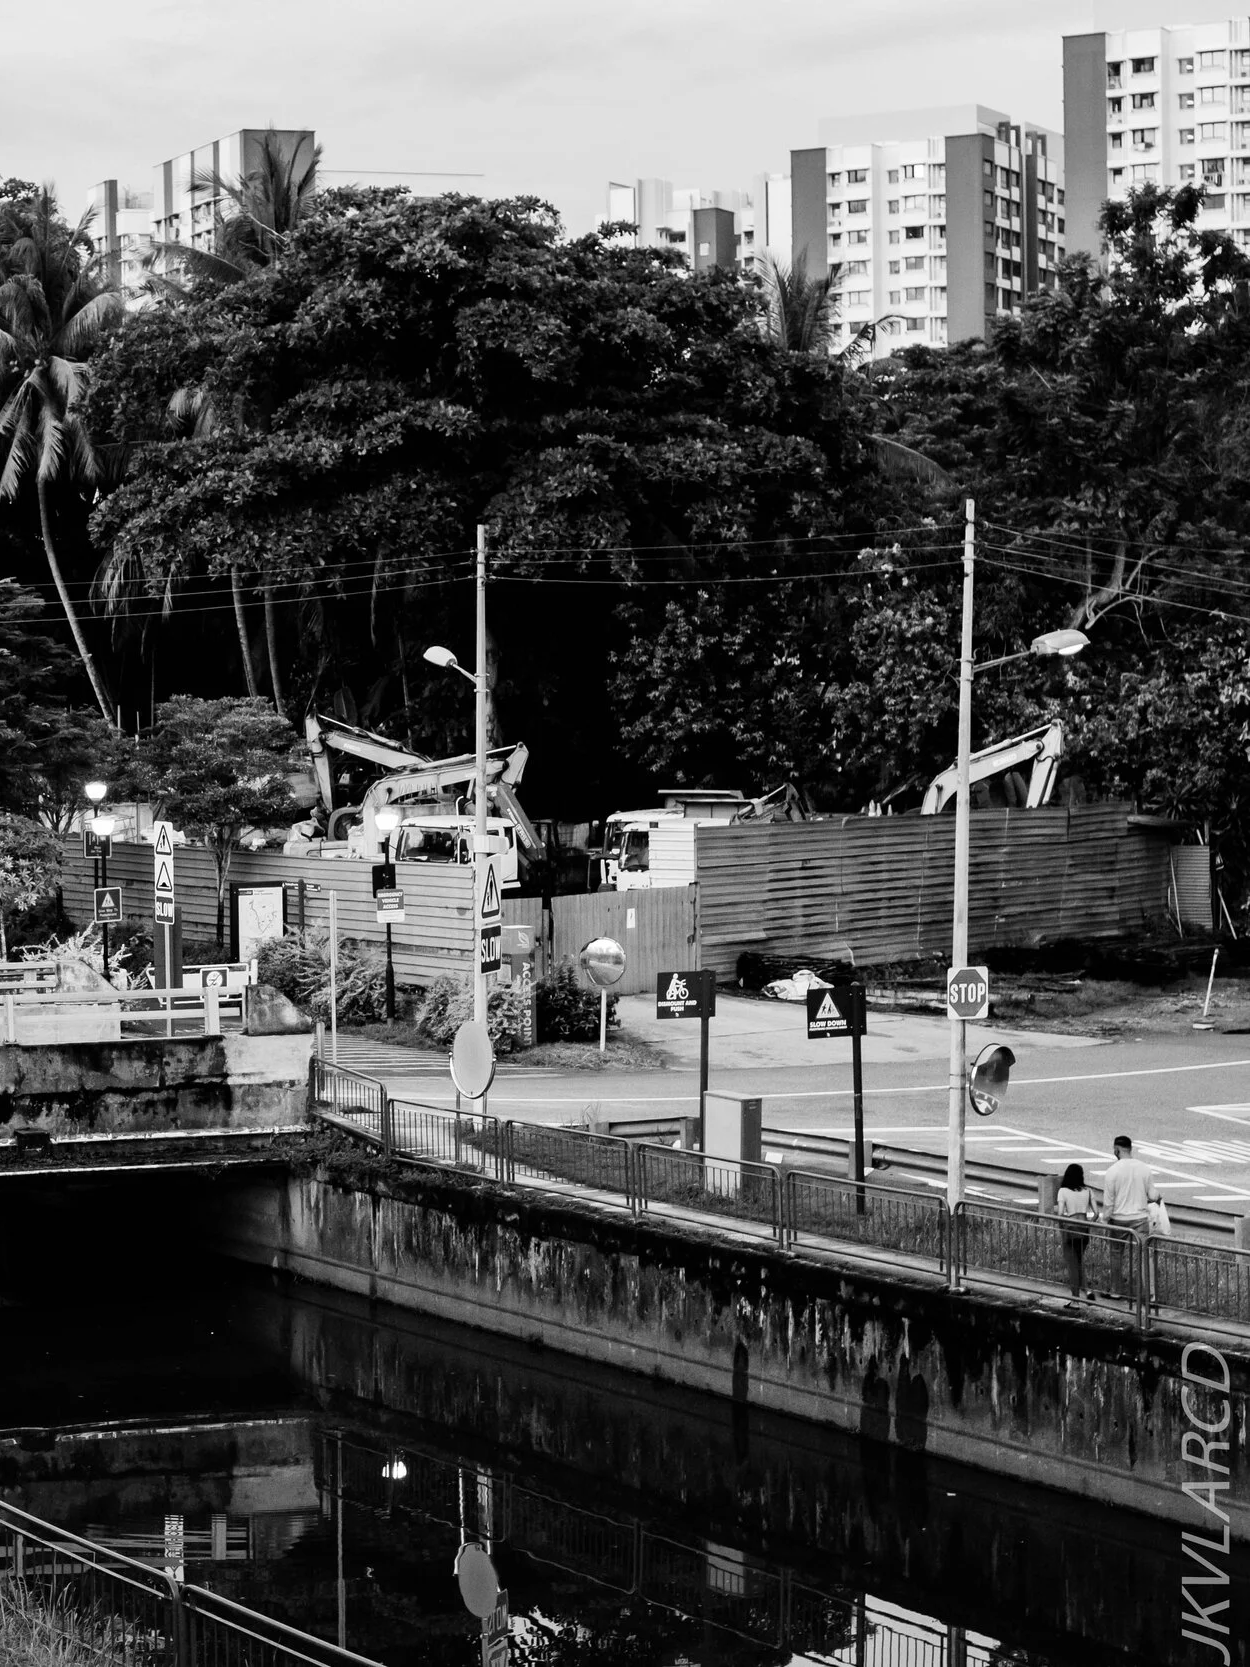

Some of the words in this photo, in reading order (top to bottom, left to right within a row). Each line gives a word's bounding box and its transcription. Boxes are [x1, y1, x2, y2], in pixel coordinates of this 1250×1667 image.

[156, 901, 174, 918] SLOW
[481, 936, 501, 963] SLOW
[950, 982, 986, 1004] STOP
[827, 1019, 847, 1027] DOWN
